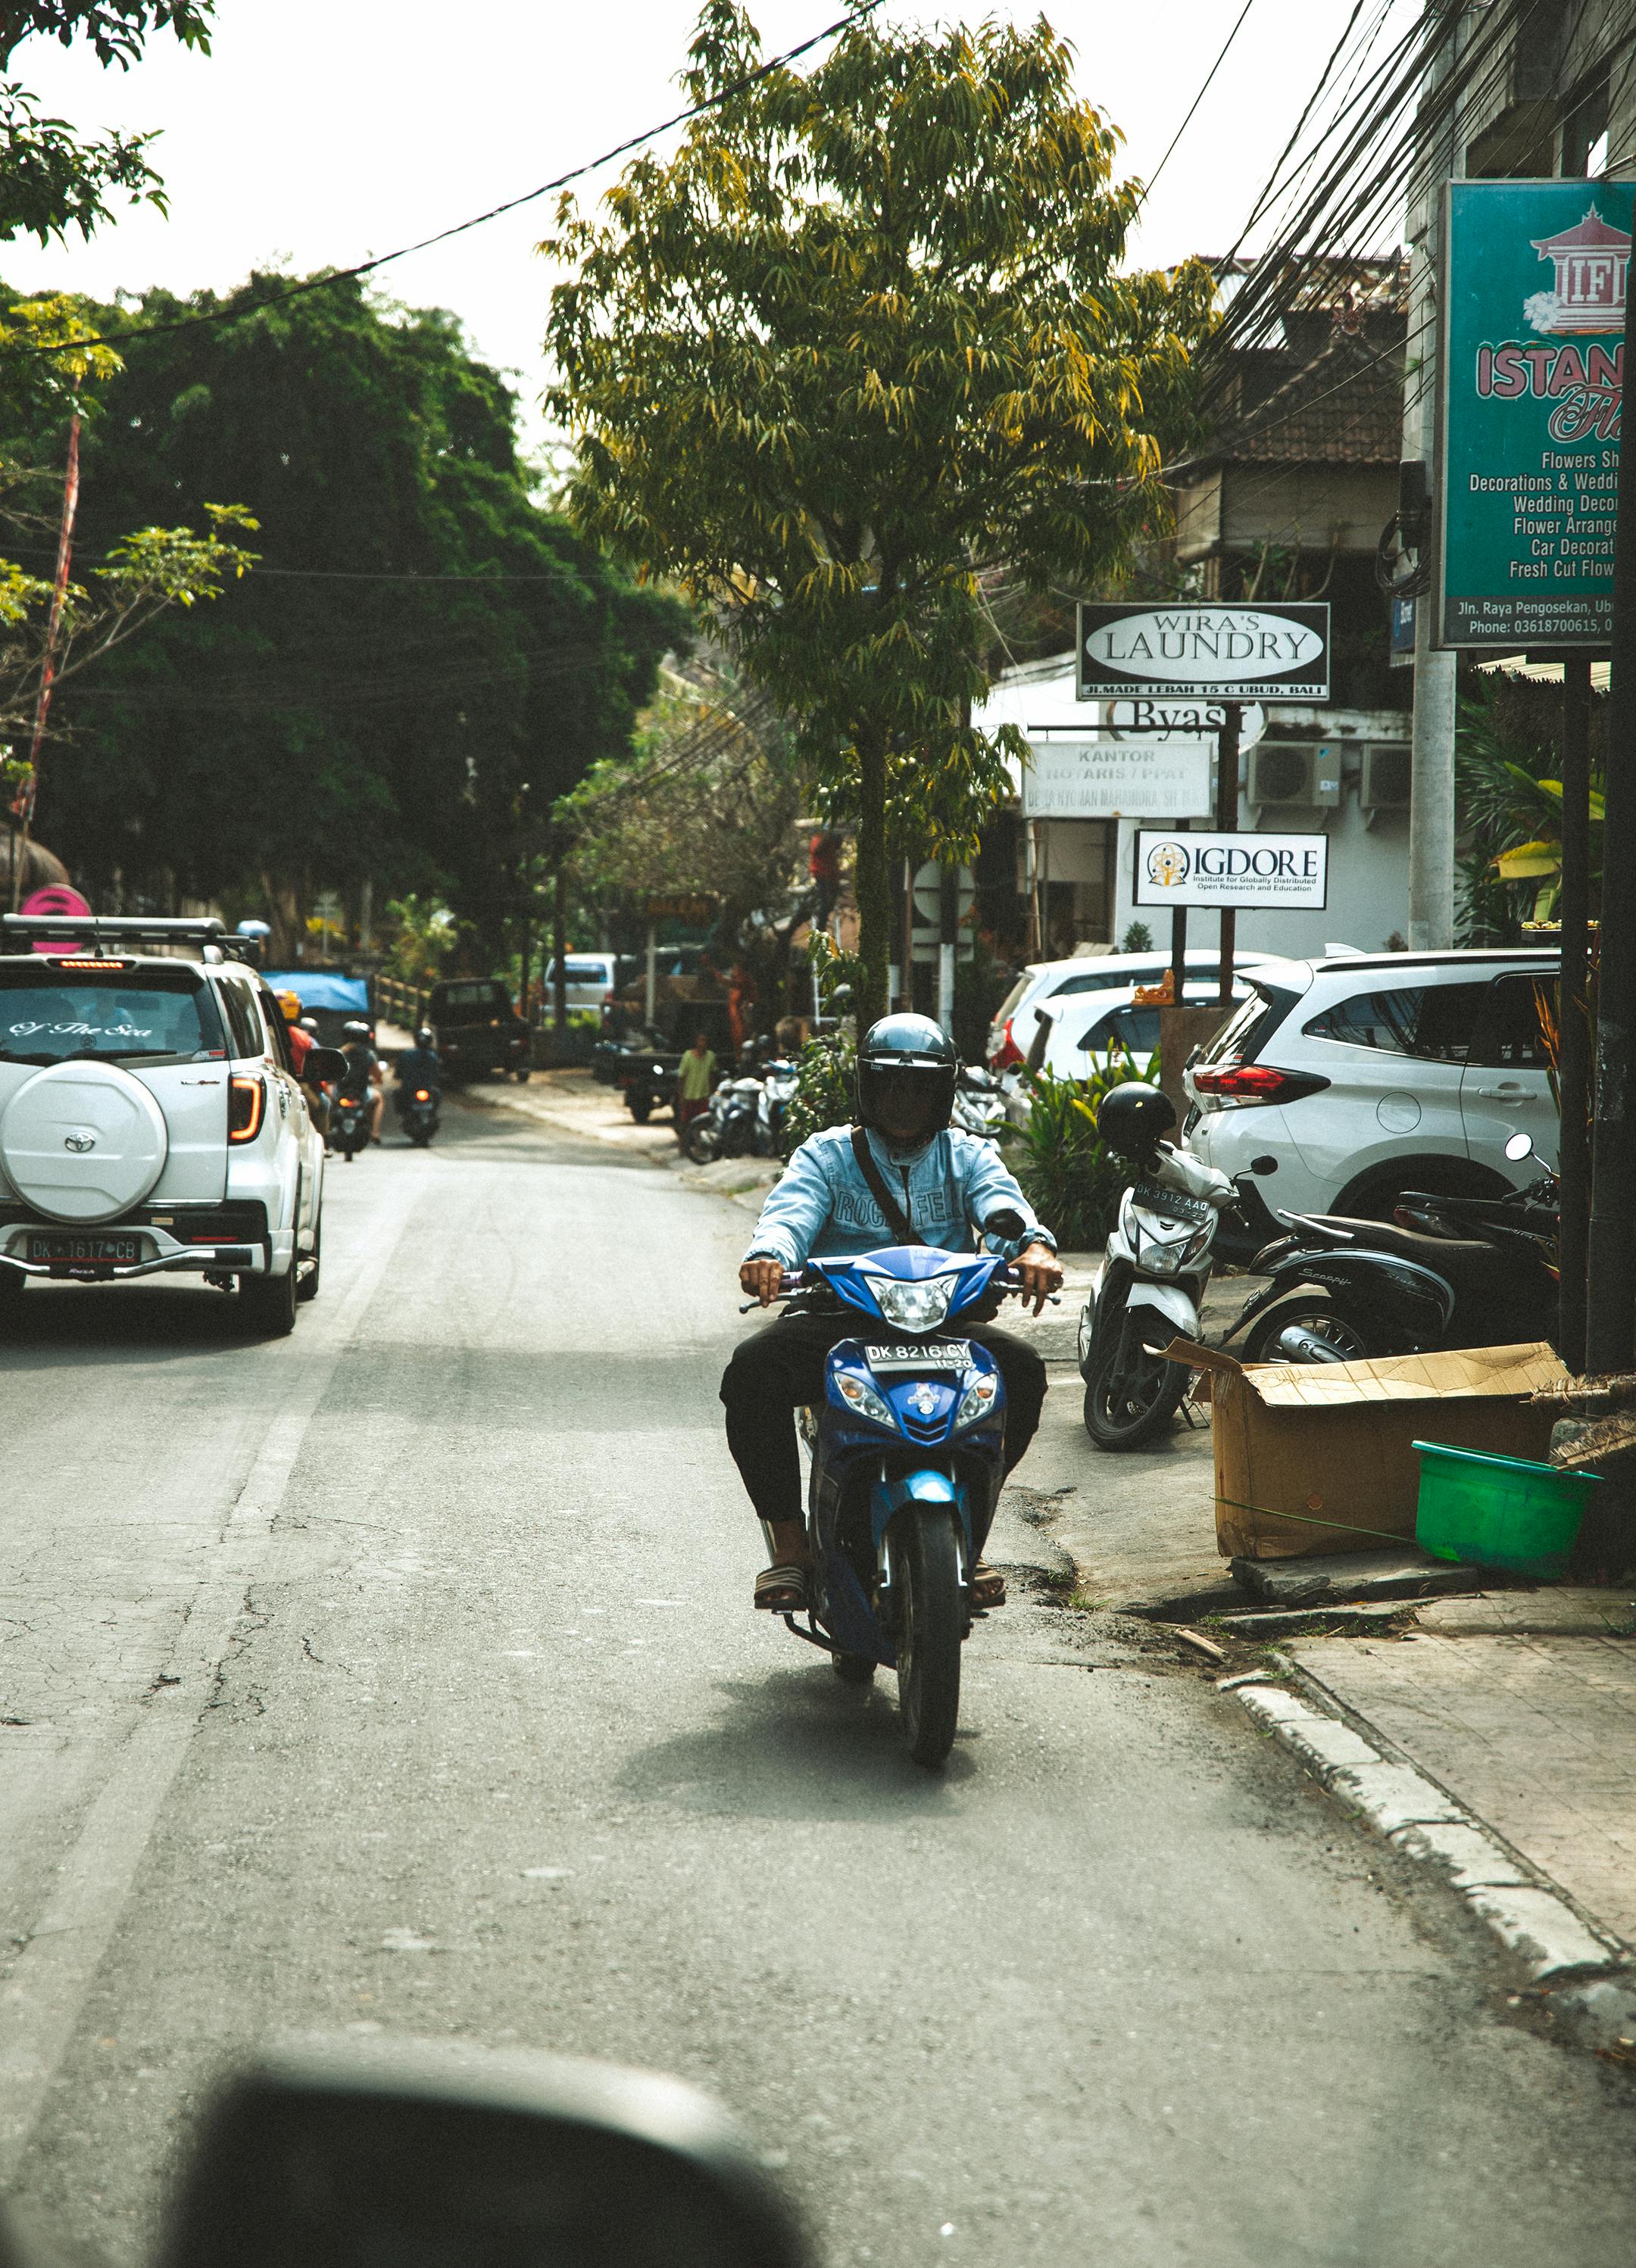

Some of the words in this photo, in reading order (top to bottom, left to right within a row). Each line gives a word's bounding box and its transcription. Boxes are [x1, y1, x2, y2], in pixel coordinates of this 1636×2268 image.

[1542, 452, 1596, 469] Flowers
[1470, 473, 1552, 491] Decorations
[1558, 473, 1568, 490] &
[1513, 494, 1574, 515] Wedding
[1513, 517, 1560, 535] Flower
[1531, 538, 1555, 556] Car
[1560, 538, 1615, 555] Decorat
[1510, 560, 1547, 578] Fresh
[1554, 560, 1576, 577] Cut
[1458, 601, 1478, 615] Jln.
[1483, 601, 1512, 617] Raya
[1516, 600, 1591, 617] Pengosekan,
[1595, 600, 1614, 613] Ub
[1152, 615, 1260, 632] WIRA'S
[1469, 619, 1510, 634] Phone:
[1514, 619, 1601, 634] 03618700615,
[1103, 632, 1310, 660] LAUNDRY
[1147, 685, 1195, 694] LEBAH
[1201, 685, 1219, 694] 15
[1224, 685, 1235, 694] C
[1289, 685, 1322, 695] BALI
[1079, 750, 1156, 763] KANTOR
[1046, 768, 1126, 781] NOARIS
[1194, 848, 1318, 877] IGDORE
[1239, 876, 1272, 884] Globally
[9, 1021, 51, 1037] Of
[49, 1022, 102, 1036] The
[105, 1023, 153, 1037] Sea
[1137, 1183, 1152, 1196] DK
[1153, 1190, 1182, 1205] 3912
[835, 1190, 886, 1227] ROC
[33, 1240, 51, 1258] DK
[69, 1241, 105, 1259] 1617
[116, 1242, 135, 1259] CB
[866, 1346, 893, 1360] DK
[895, 1345, 943, 1359] 8216
[946, 1343, 968, 1358] CY
